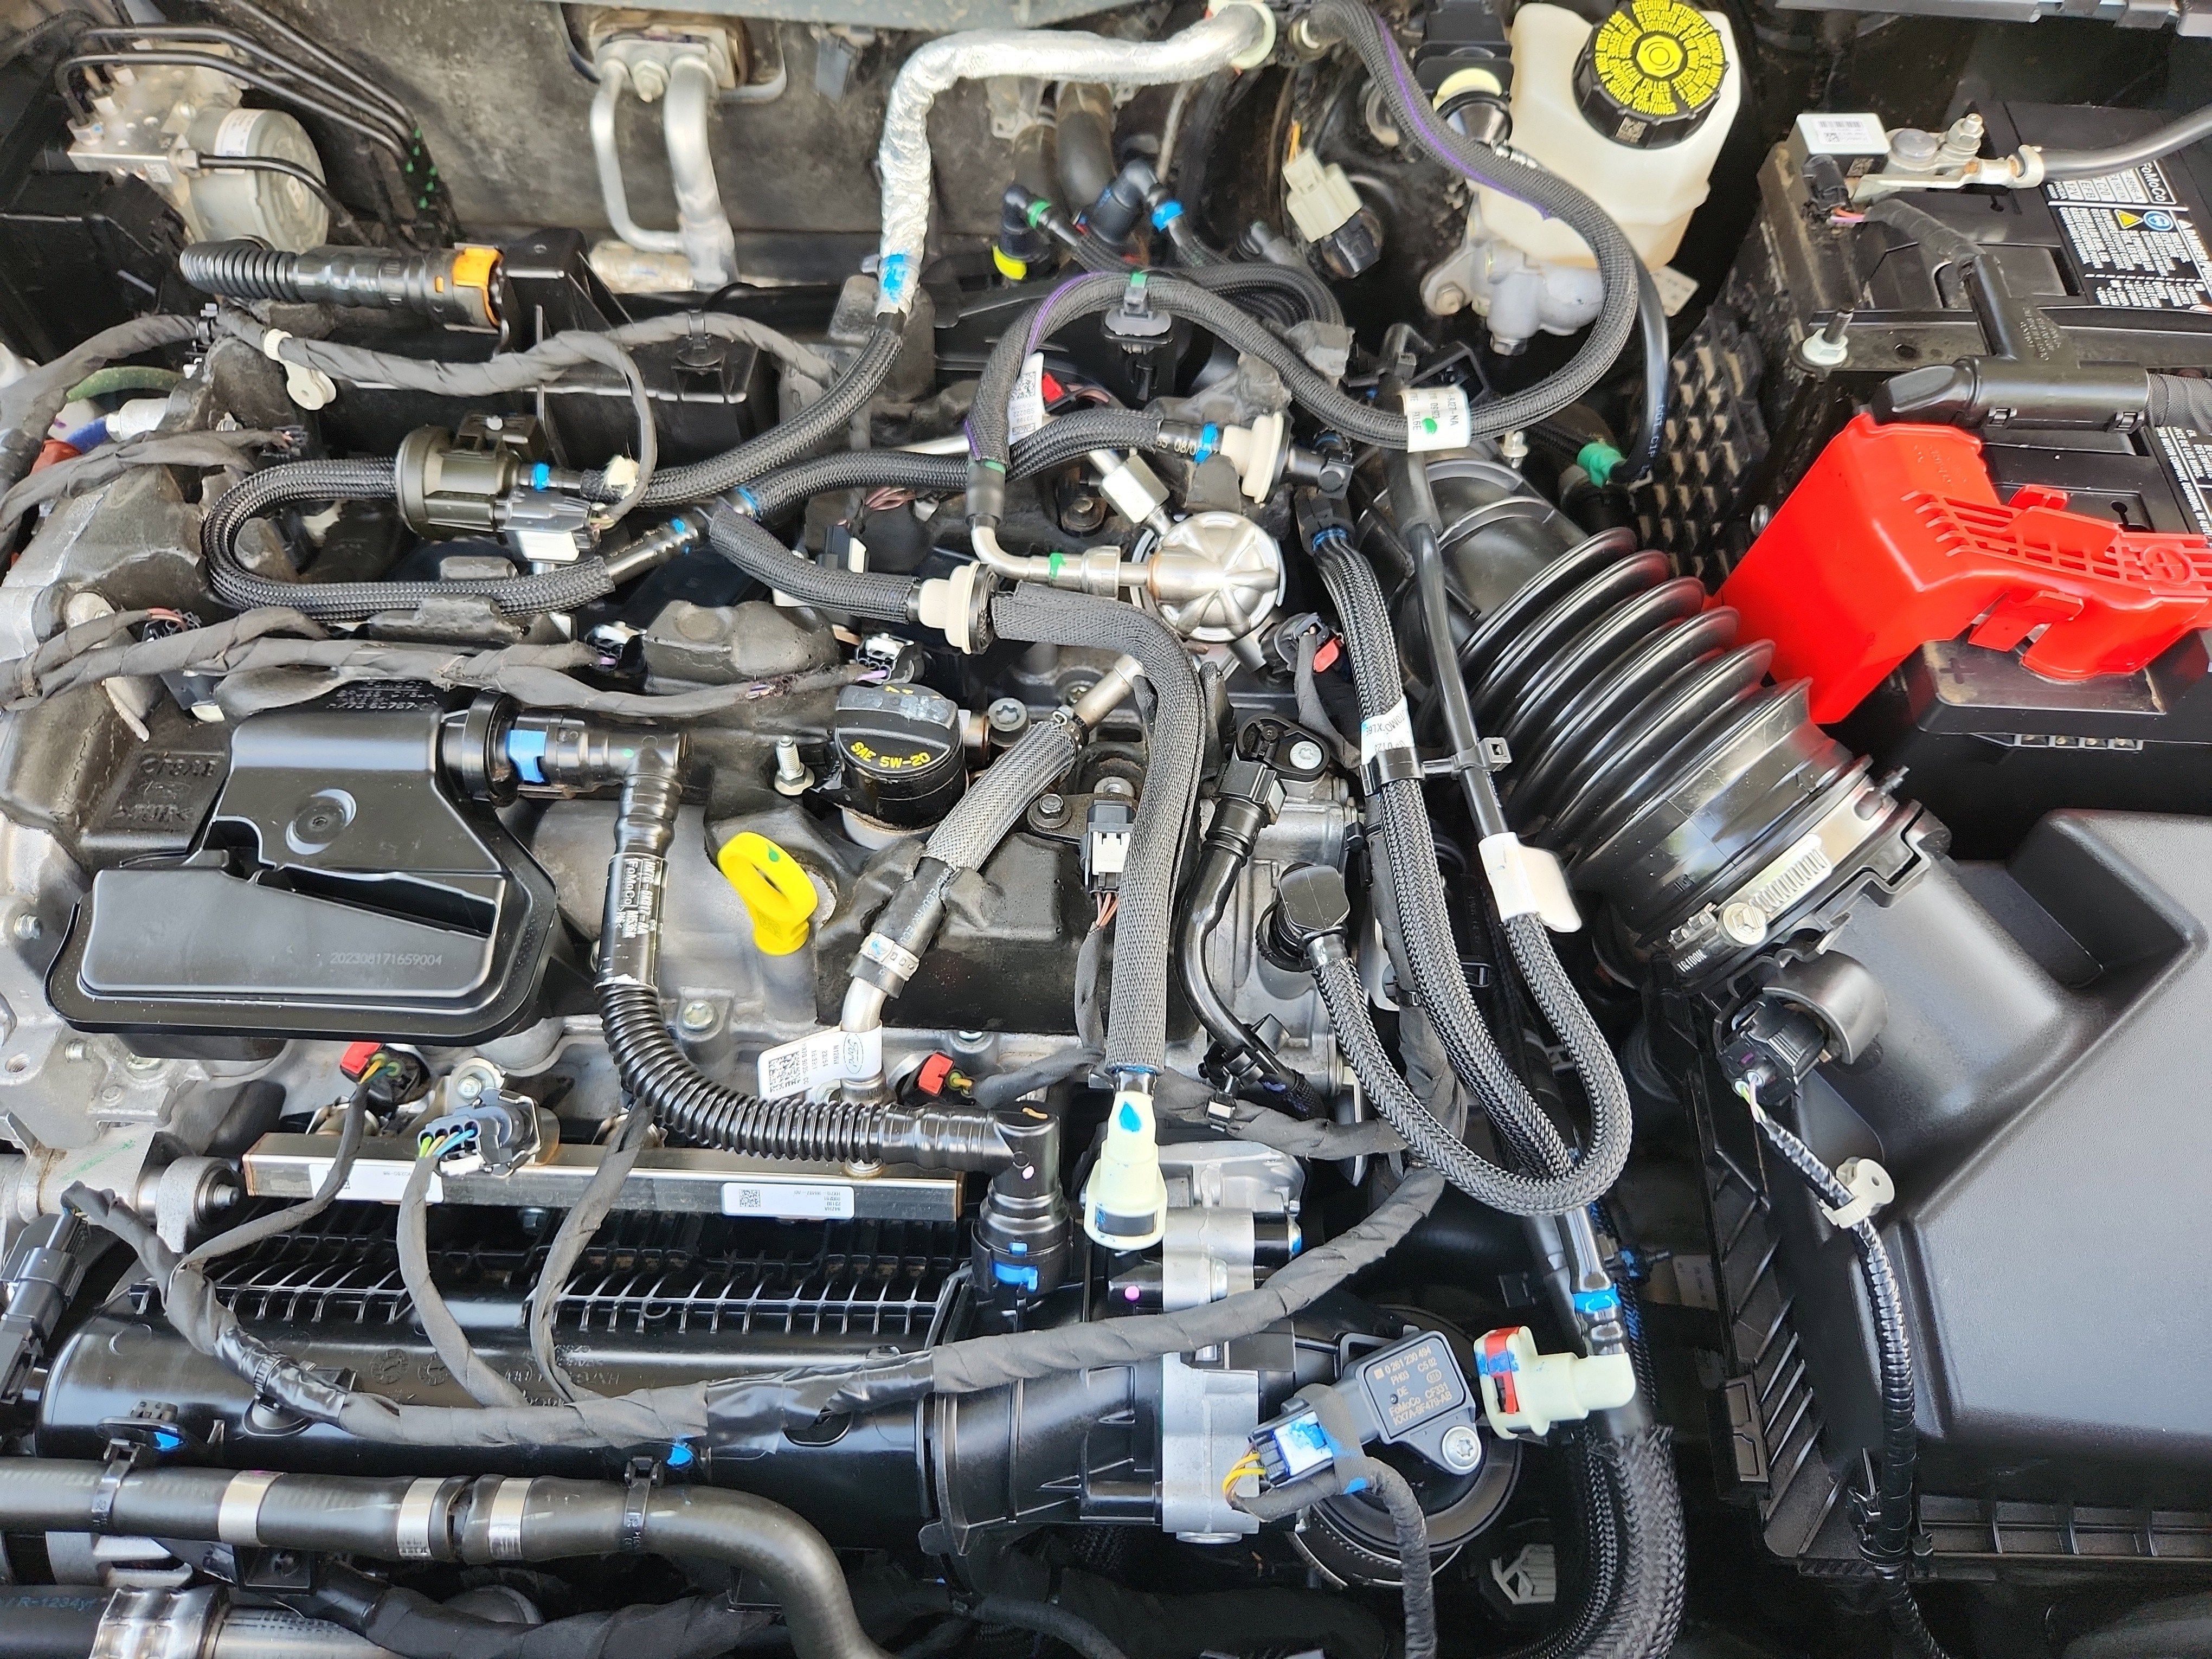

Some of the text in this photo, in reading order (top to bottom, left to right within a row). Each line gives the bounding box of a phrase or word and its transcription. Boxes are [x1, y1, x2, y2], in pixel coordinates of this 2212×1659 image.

[1671, 3, 1706, 28] NETTOYER
[1699, 22, 1713, 36] LE
[1595, 52, 1611, 74] FROM
[1605, 79, 1634, 105] SEALED
[1632, 98, 1678, 115] CONTAINER
[1621, 60, 1643, 86] CLEAN
[1640, 78, 1670, 94] FILLER
[1633, 86, 1652, 102] USE
[1651, 91, 1671, 104] ONLY
[2066, 184, 2081, 197] 12V
[2081, 183, 2096, 198] EFB
[2141, 162, 2166, 201] FoMoCo
[2058, 207, 2074, 224] CAUSAR
[2090, 208, 2101, 217] DES
[2068, 207, 2104, 269] GASES EXPLOSIVOS PUEDEN
[2078, 208, 2096, 228] PROTEJA
[2087, 228, 2100, 239] LOS
[2098, 252, 2111, 262] LOS
[2094, 217, 2112, 241] BLESSURES
[2099, 209, 2136, 271] EXPLOSIFS PEUVENT CAUSER
[2140, 230, 2158, 254] BLINDNESS
[2158, 232, 2179, 258] EXPLOSIVE
[2150, 232, 2176, 271] GASES CAN CAUSE
[2143, 261, 2156, 272] LES
[2134, 284, 2146, 293] LES
[2143, 284, 2156, 293] LES
[2165, 285, 2183, 307] SMOKING
[2175, 286, 2191, 305] FLAMES
[2185, 286, 2201, 304] SPARKS
[2160, 438, 2177, 456] MOTOR
[2182, 448, 2196, 459] LOS
[2193, 444, 2206, 454] DES
[2188, 459, 2204, 479] NIÑOS.
[851, 742, 931, 769] SAE 5W-20
[625, 860, 638, 905] FoMoCo
[330, 952, 442, 966] 202308171659004
[847, 1038, 860, 1068] Ford
[1390, 1359, 1404, 1372] 261
[1397, 1385, 1410, 1398] DE
[1389, 1397, 1421, 1417] FoMoCo
